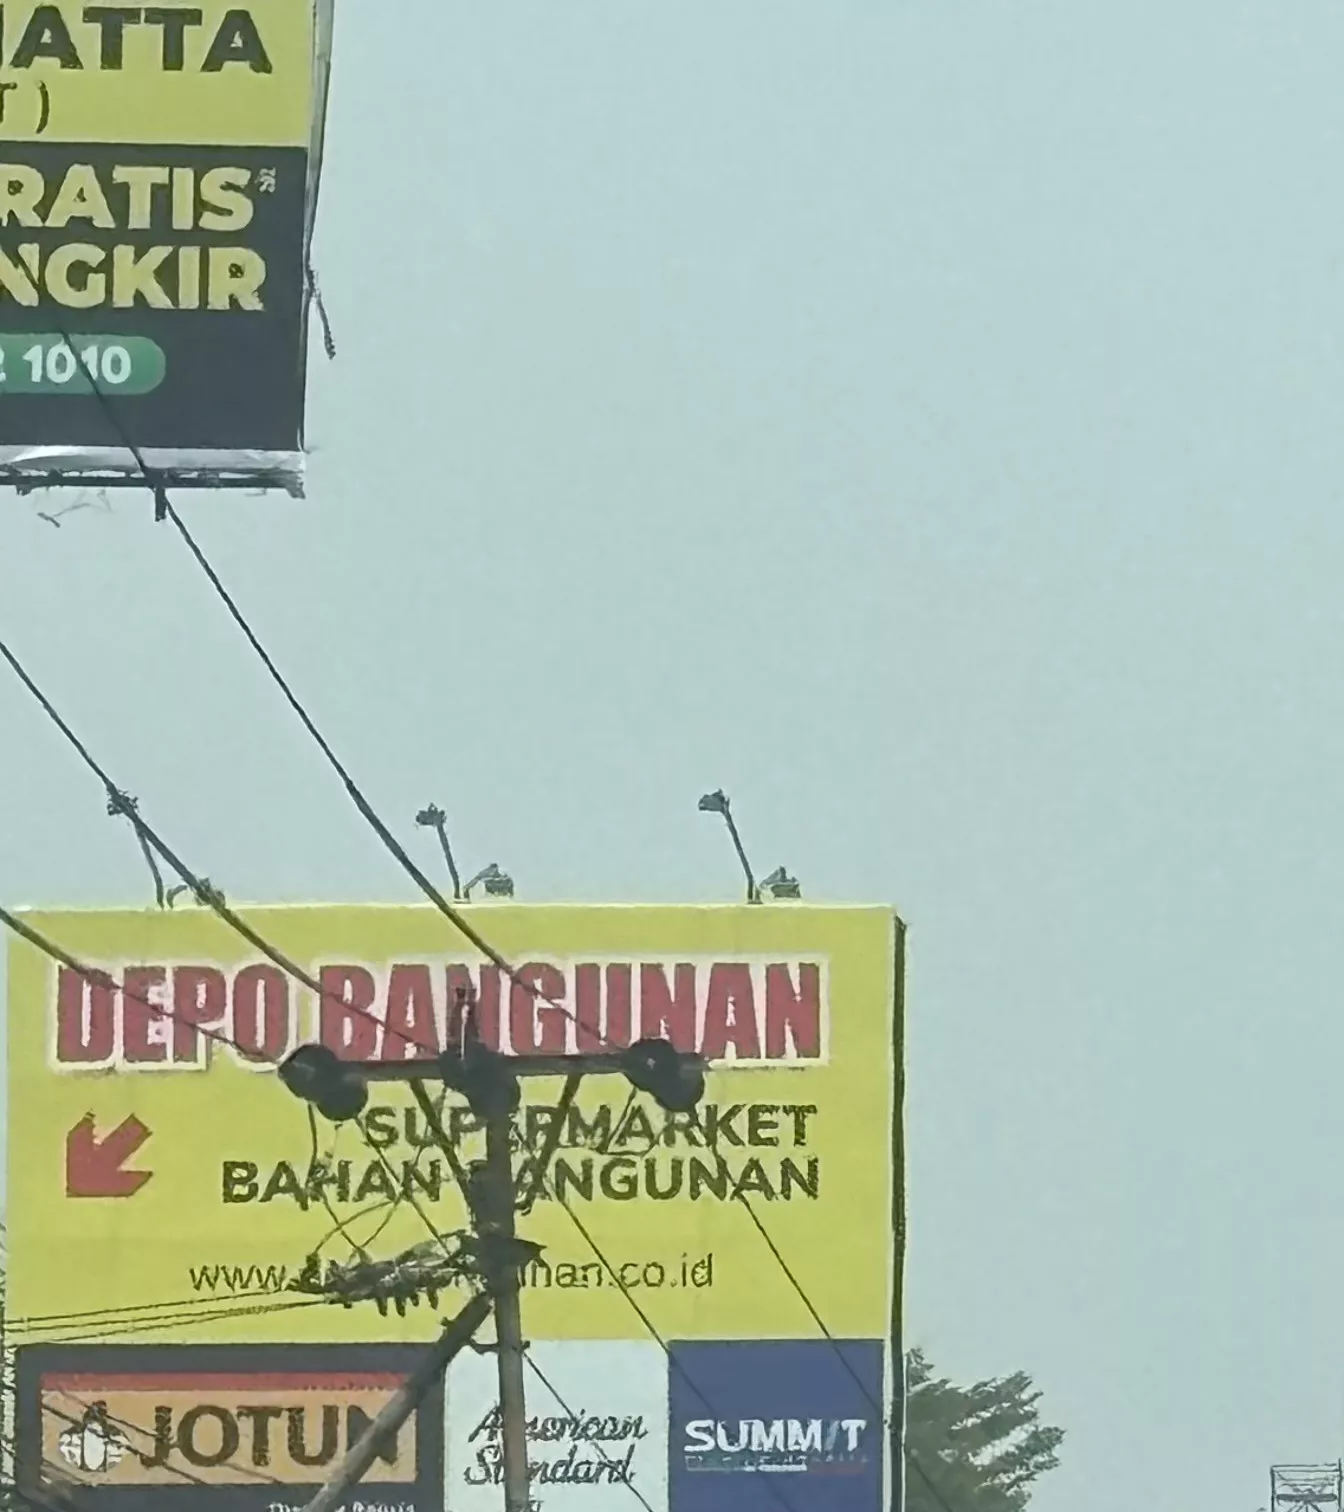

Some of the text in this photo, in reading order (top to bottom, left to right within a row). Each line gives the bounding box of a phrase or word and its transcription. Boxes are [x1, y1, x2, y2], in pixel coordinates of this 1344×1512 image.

[0, 5, 272, 74] ATTA
[57, 962, 821, 1063] DEPO BANGUNAN
[222, 1156, 820, 1205] BAHAN ANGUNAN
[139, 1405, 398, 1466] JOTUN
[684, 1419, 867, 1453] SUMMIT
